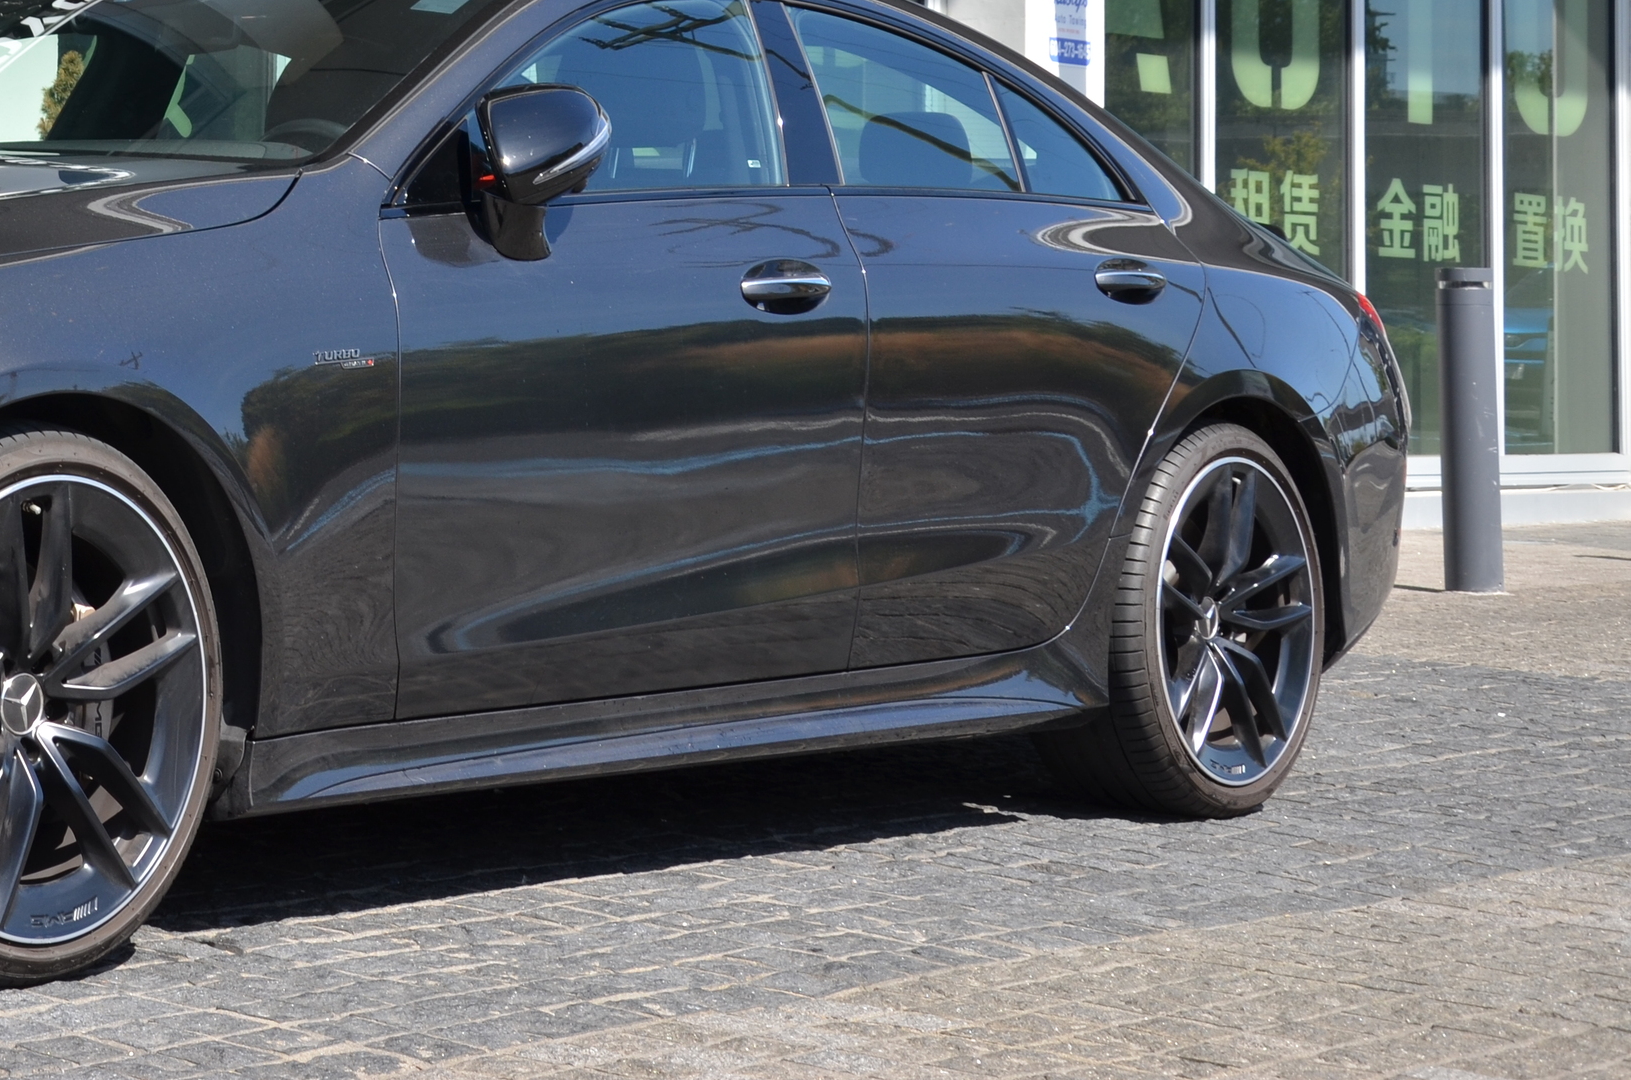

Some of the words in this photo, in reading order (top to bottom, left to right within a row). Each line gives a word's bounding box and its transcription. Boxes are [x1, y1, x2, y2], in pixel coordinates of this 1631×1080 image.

[1377, 178, 1461, 263] 金融
[1513, 192, 1589, 274] 置换
[313, 348, 360, 361] TURBO
